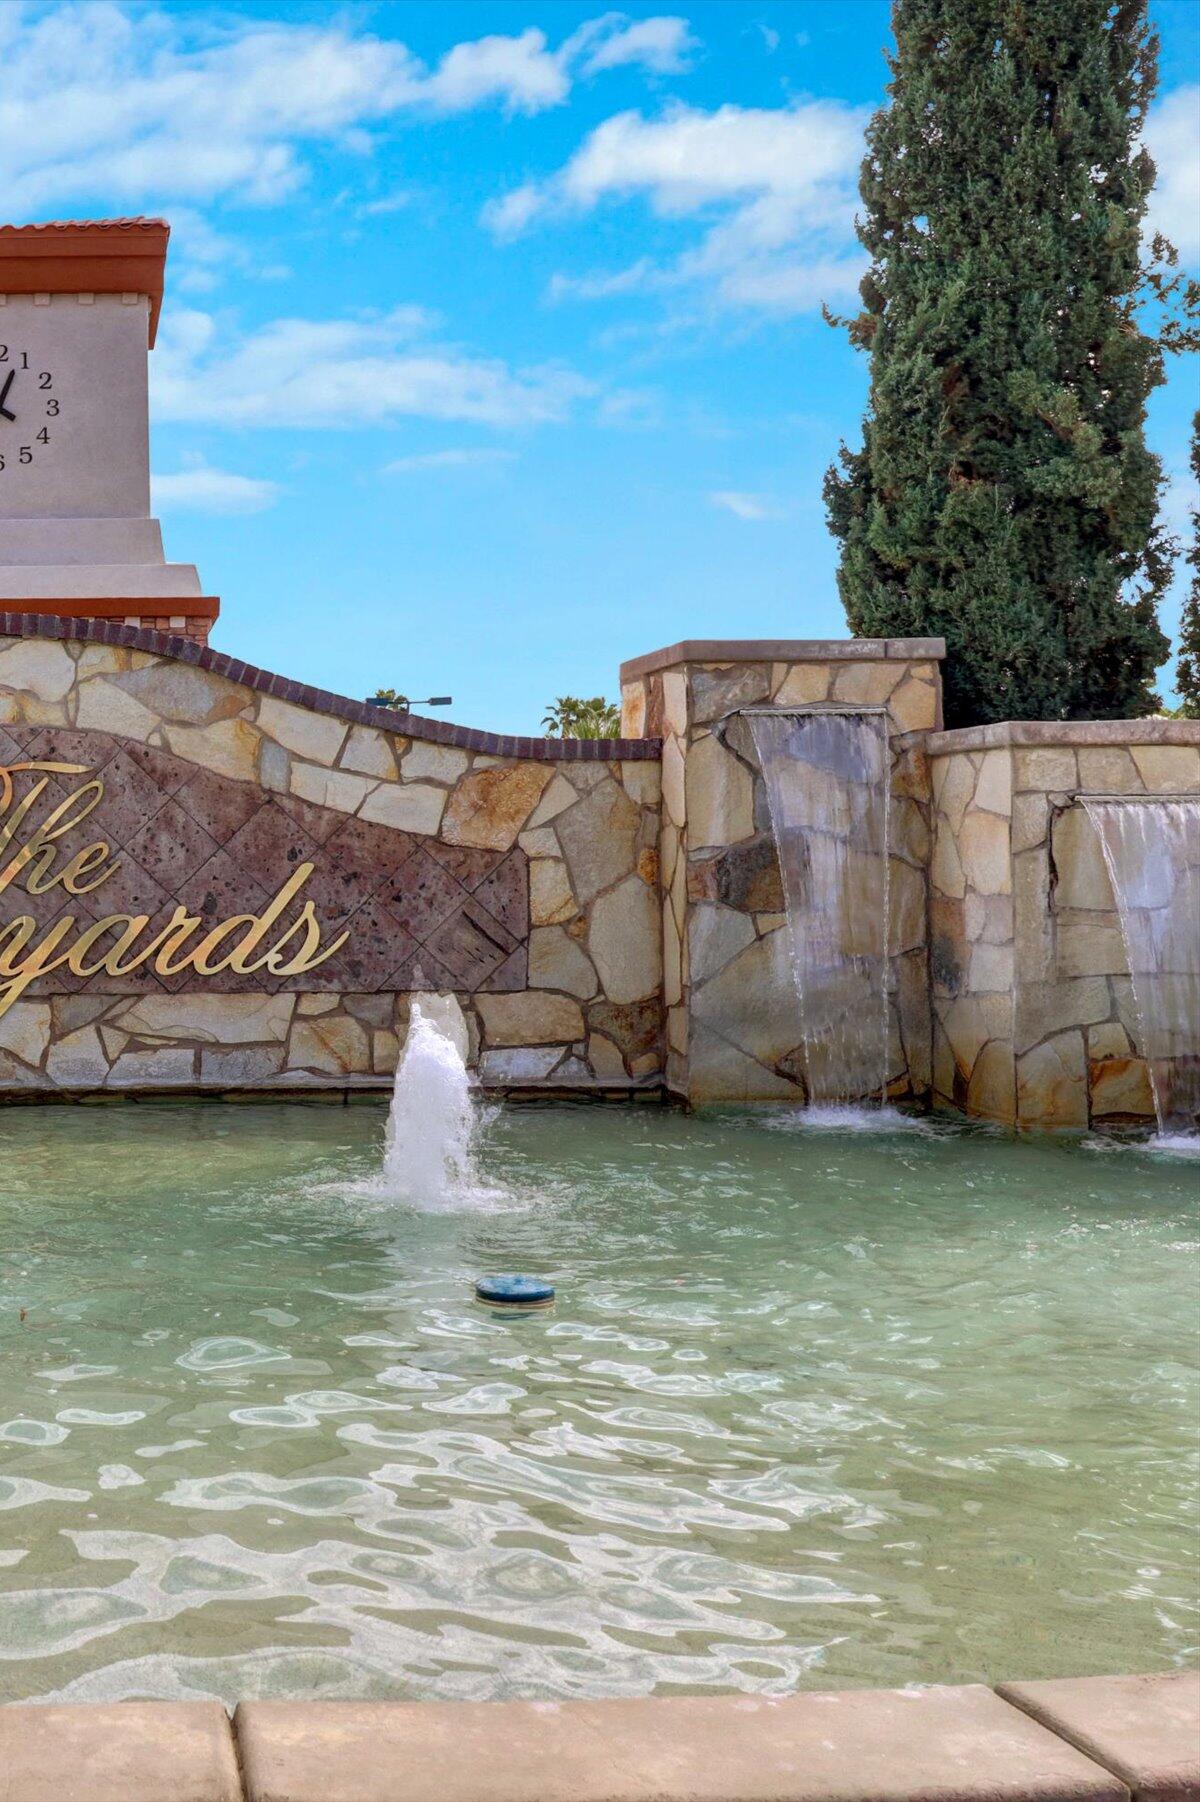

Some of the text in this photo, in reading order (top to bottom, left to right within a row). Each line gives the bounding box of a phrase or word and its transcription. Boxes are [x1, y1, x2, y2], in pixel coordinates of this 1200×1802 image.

[20, 352, 30, 369] 1
[38, 372, 53, 389] 2
[46, 399, 60, 416] 3
[36, 427, 51, 444] 4
[19, 446, 33, 464] 5
